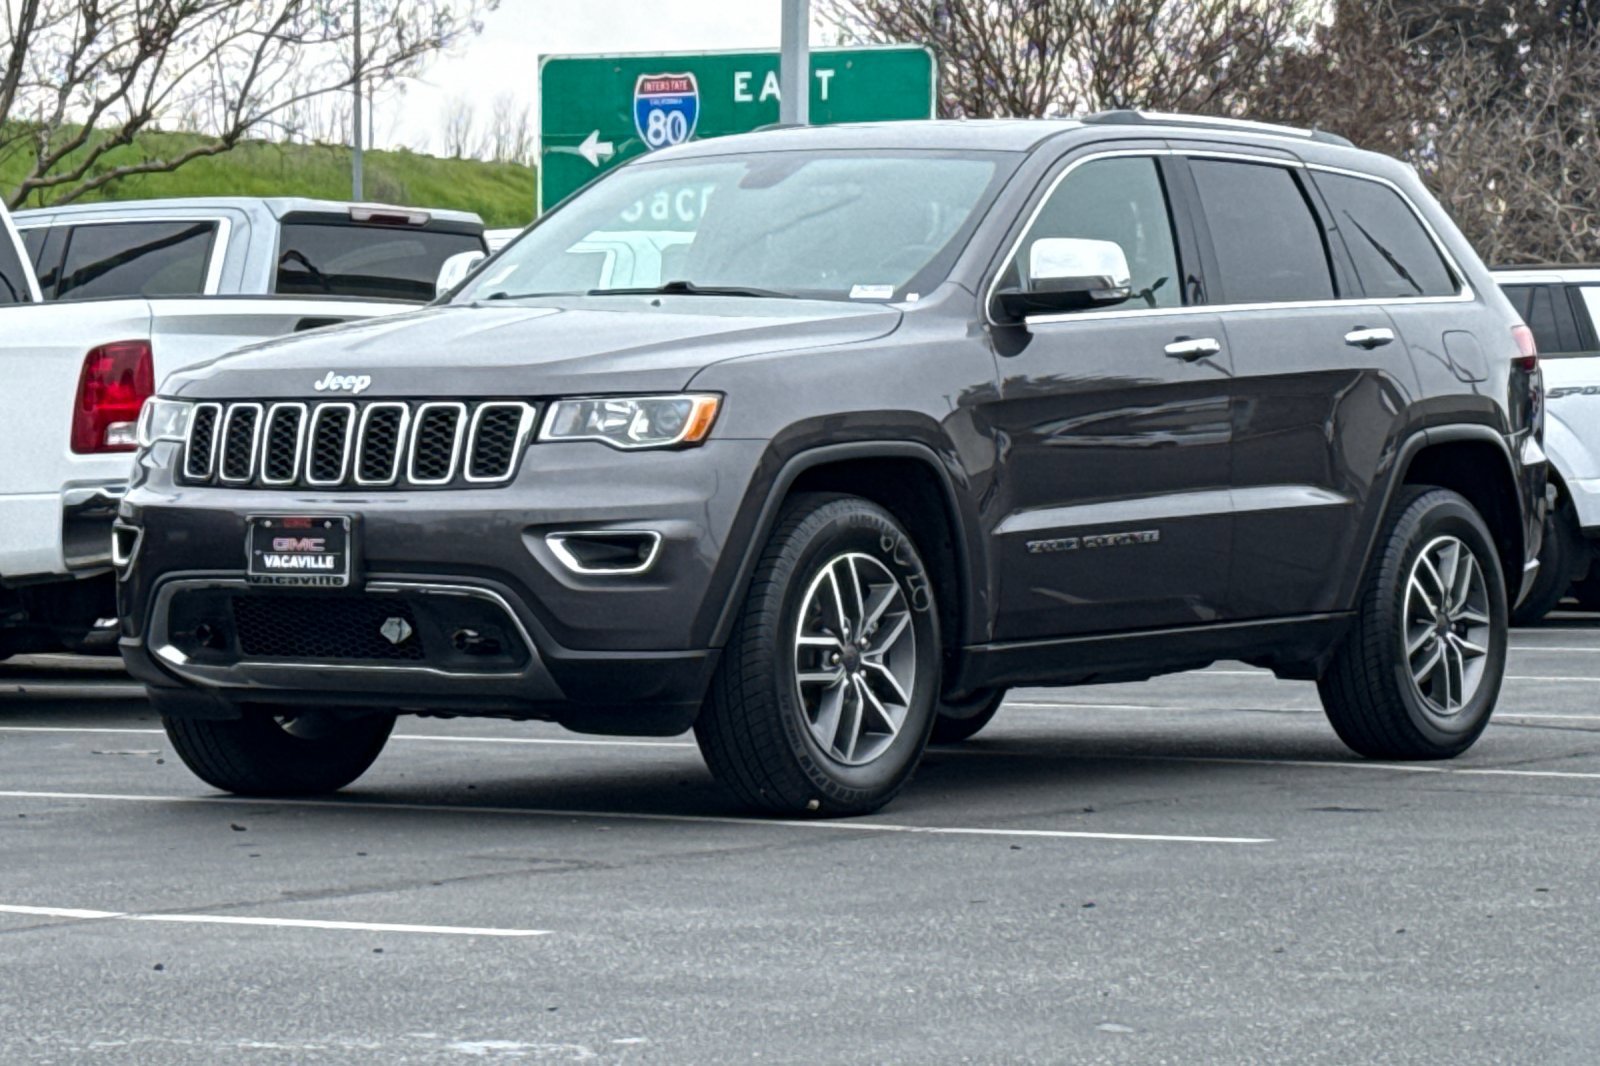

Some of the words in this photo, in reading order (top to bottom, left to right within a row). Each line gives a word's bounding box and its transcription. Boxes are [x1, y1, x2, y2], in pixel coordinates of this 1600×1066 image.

[643, 79, 689, 92] INTERSTATE
[734, 69, 835, 102] EAT
[647, 108, 687, 146] 80
[314, 370, 371, 394] Jeep
[1545, 385, 1600, 399] SPO
[273, 537, 326, 552] GMC
[263, 554, 334, 569] VACAVILLE
